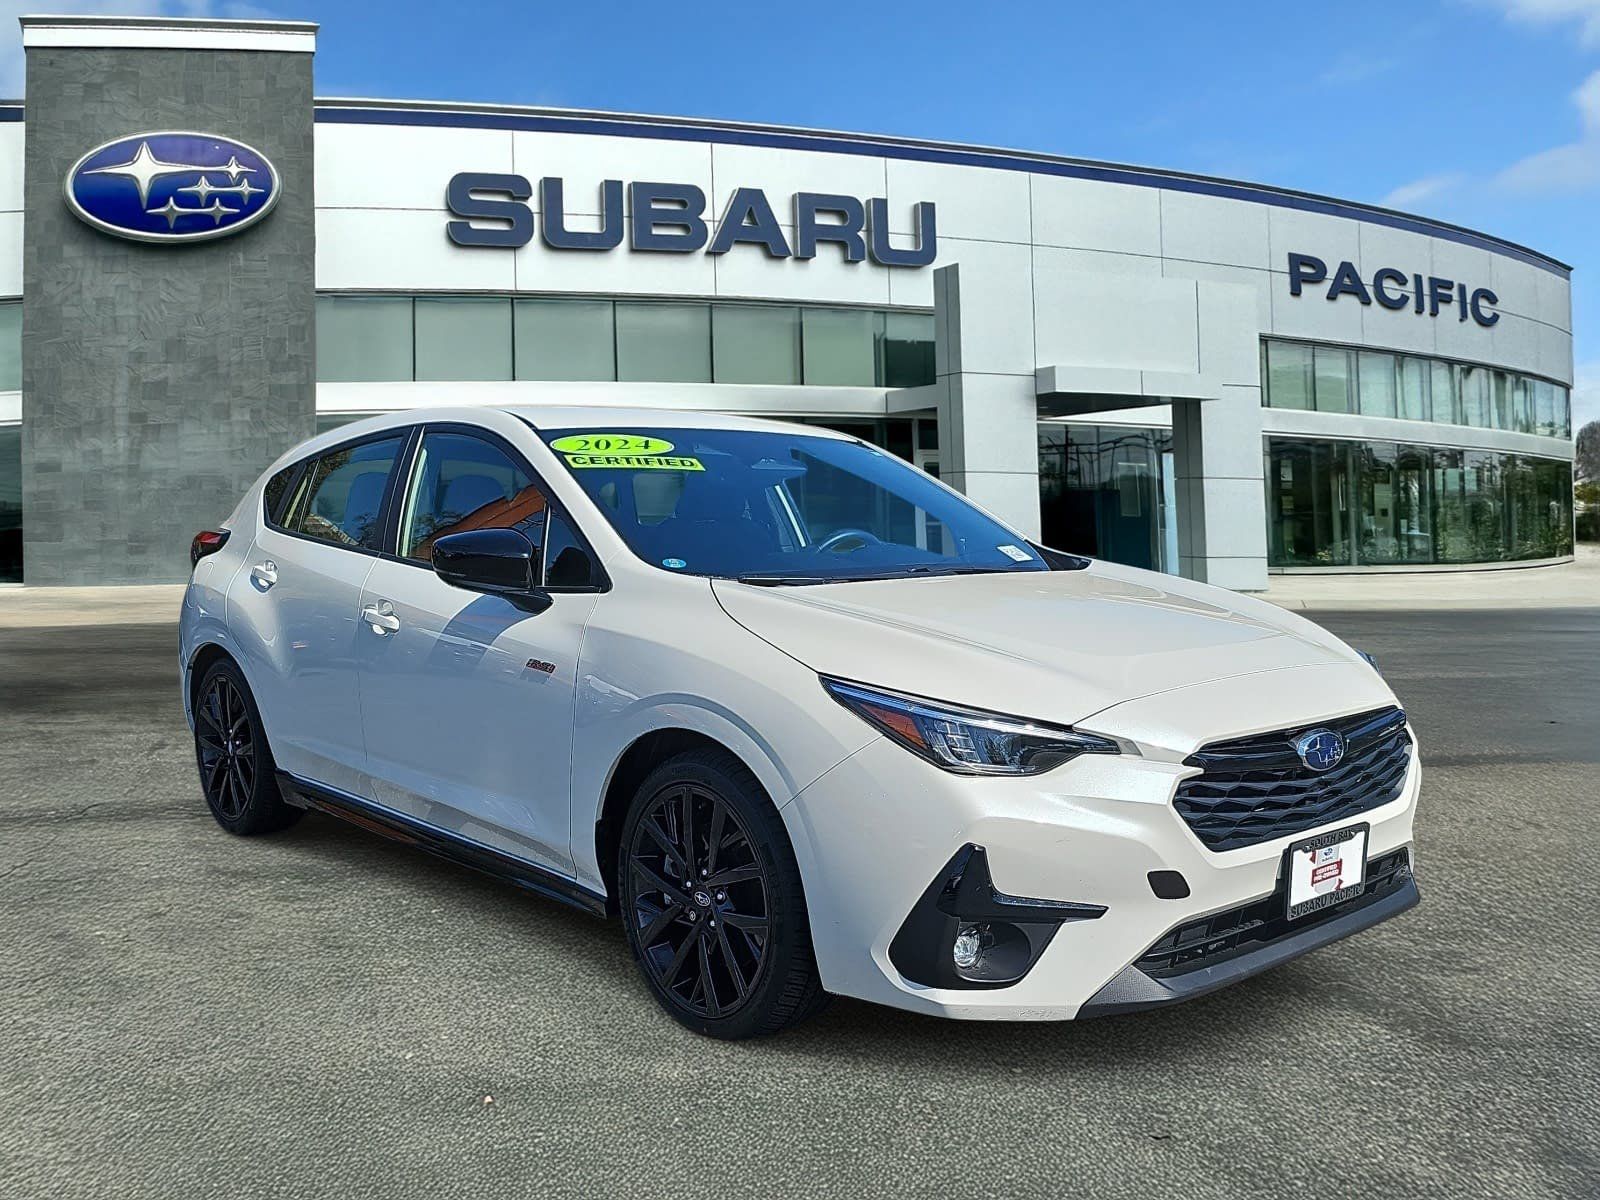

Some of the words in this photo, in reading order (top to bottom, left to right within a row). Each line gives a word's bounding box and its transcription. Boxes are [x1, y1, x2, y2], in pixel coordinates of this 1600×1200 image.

[446, 171, 937, 267] SUBARU
[1287, 252, 1500, 327] PACIFIC
[575, 438, 652, 451] 2024
[571, 456, 696, 468] CERTIFIED
[1309, 832, 1336, 849] SOUTH
[1290, 895, 1327, 919] SUBARU
[1329, 884, 1362, 905] PACIFIC
